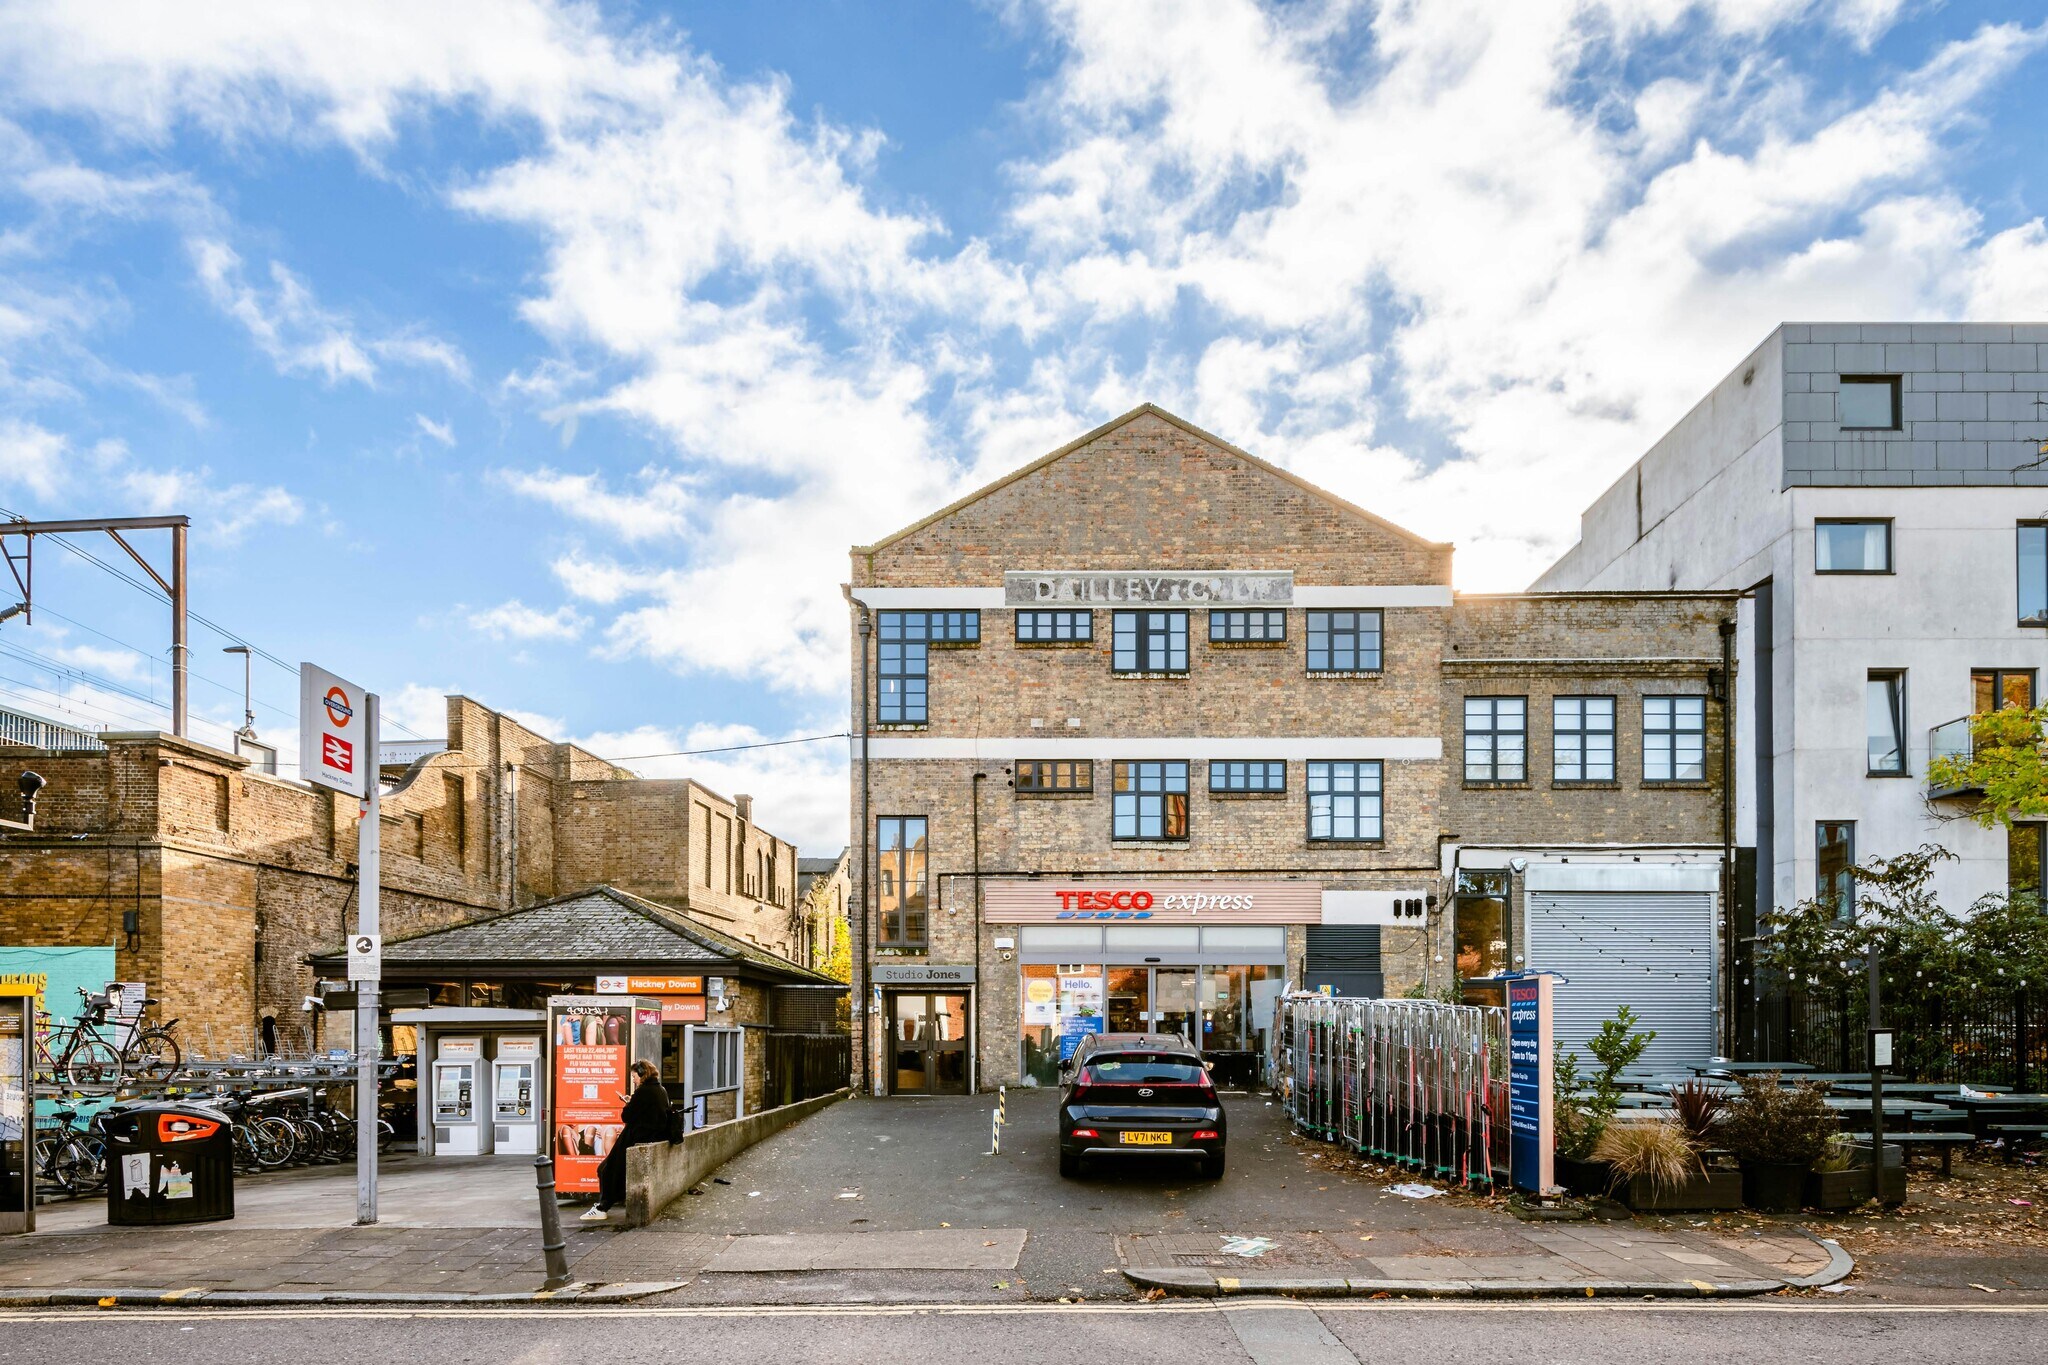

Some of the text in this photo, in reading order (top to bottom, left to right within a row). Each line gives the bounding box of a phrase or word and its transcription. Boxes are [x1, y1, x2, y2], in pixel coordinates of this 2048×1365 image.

[1035, 578, 1163, 600] DAILLEY
[325, 699, 352, 716] OVERGROUND
[321, 771, 352, 788] Hackney Downs
[1055, 891, 1254, 915] TESCO express
[886, 970, 961, 980] Studio Jones
[631, 980, 697, 990] Hackney Downs
[1064, 980, 1092, 989] Hello.
[1511, 988, 1537, 1000] TESCO
[674, 1003, 700, 1012] Downs
[1512, 1009, 1536, 1024] express
[1511, 1038, 1520, 1048] Open
[1520, 1040, 1530, 1049] every
[1511, 1050, 1537, 1063] 7am to 11pm
[1127, 1133, 1168, 1142] LV71 NKC
